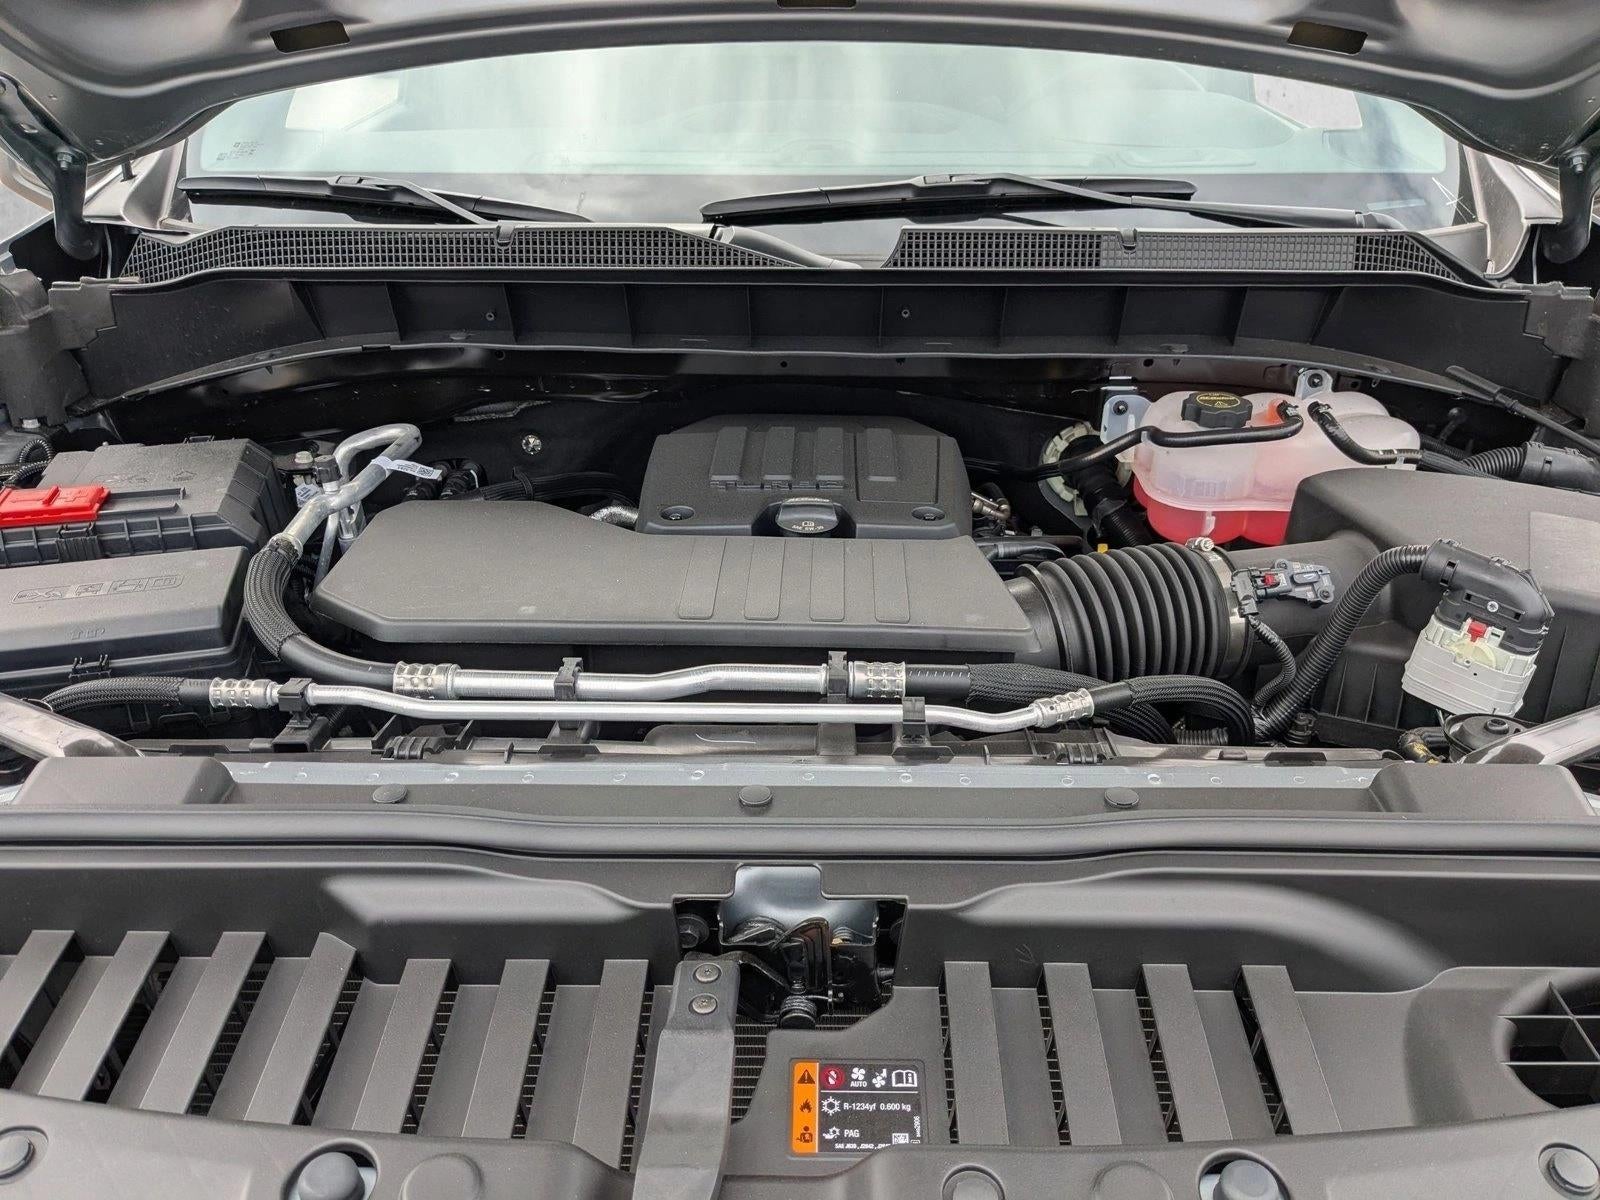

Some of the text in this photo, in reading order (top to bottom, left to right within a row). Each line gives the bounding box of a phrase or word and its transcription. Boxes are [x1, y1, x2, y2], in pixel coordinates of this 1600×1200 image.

[843, 1102, 912, 1112] R-1234yf 0.600 kg
[844, 1129, 860, 1138] PAG
